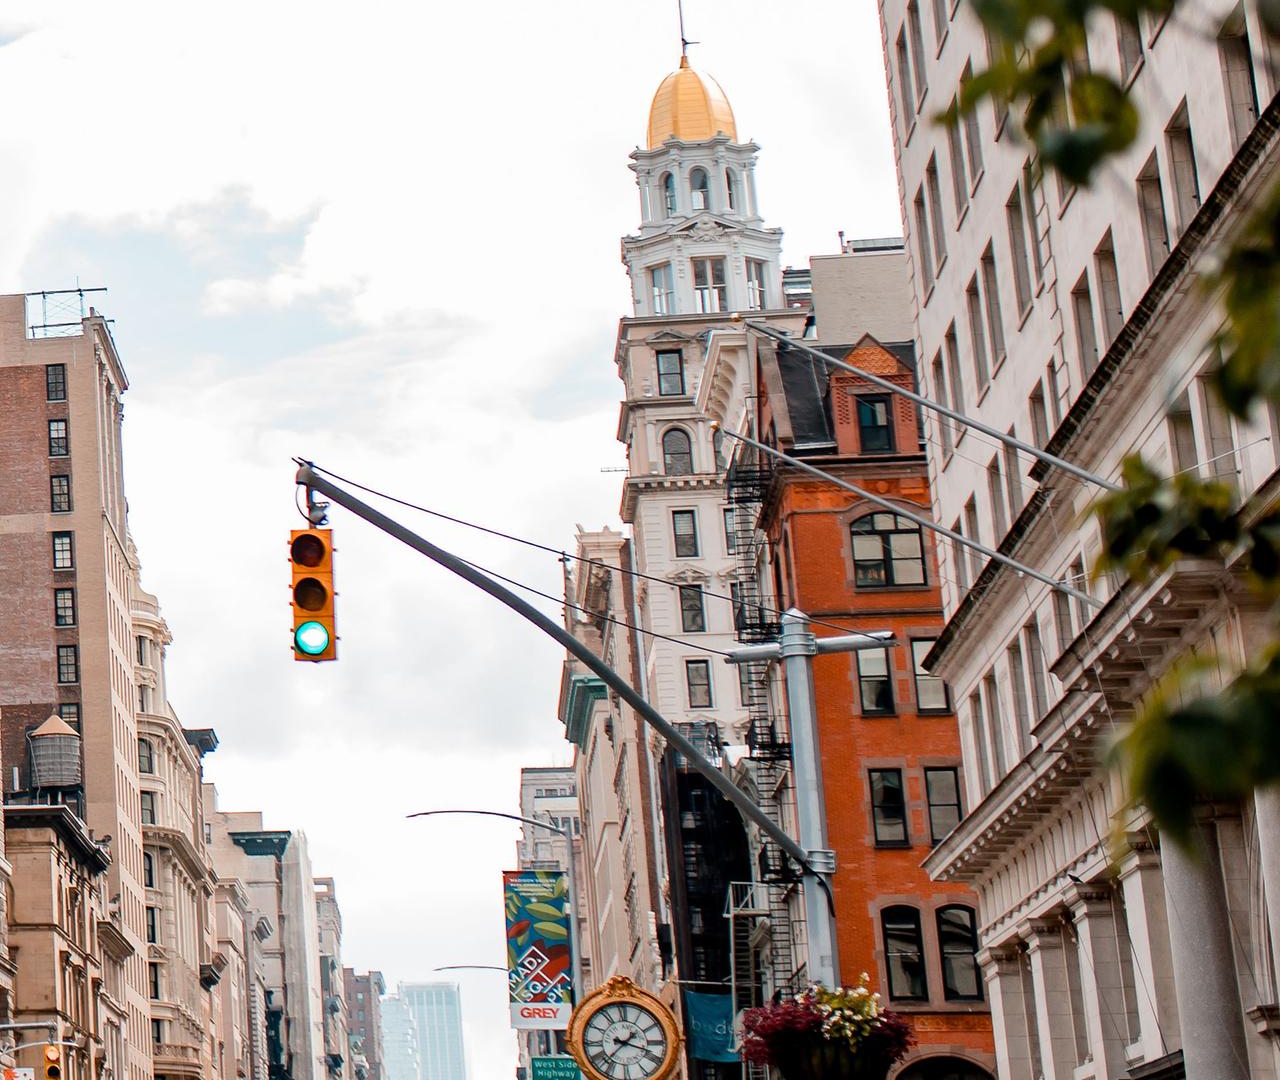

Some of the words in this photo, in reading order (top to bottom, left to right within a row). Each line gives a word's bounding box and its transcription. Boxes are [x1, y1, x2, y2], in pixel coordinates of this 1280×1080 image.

[509, 957, 542, 988] MAD.
[521, 981, 547, 1001] SQ.
[547, 983, 571, 1004] PK.
[520, 1007, 560, 1018] GREY
[537, 1070, 576, 1079] Highway
